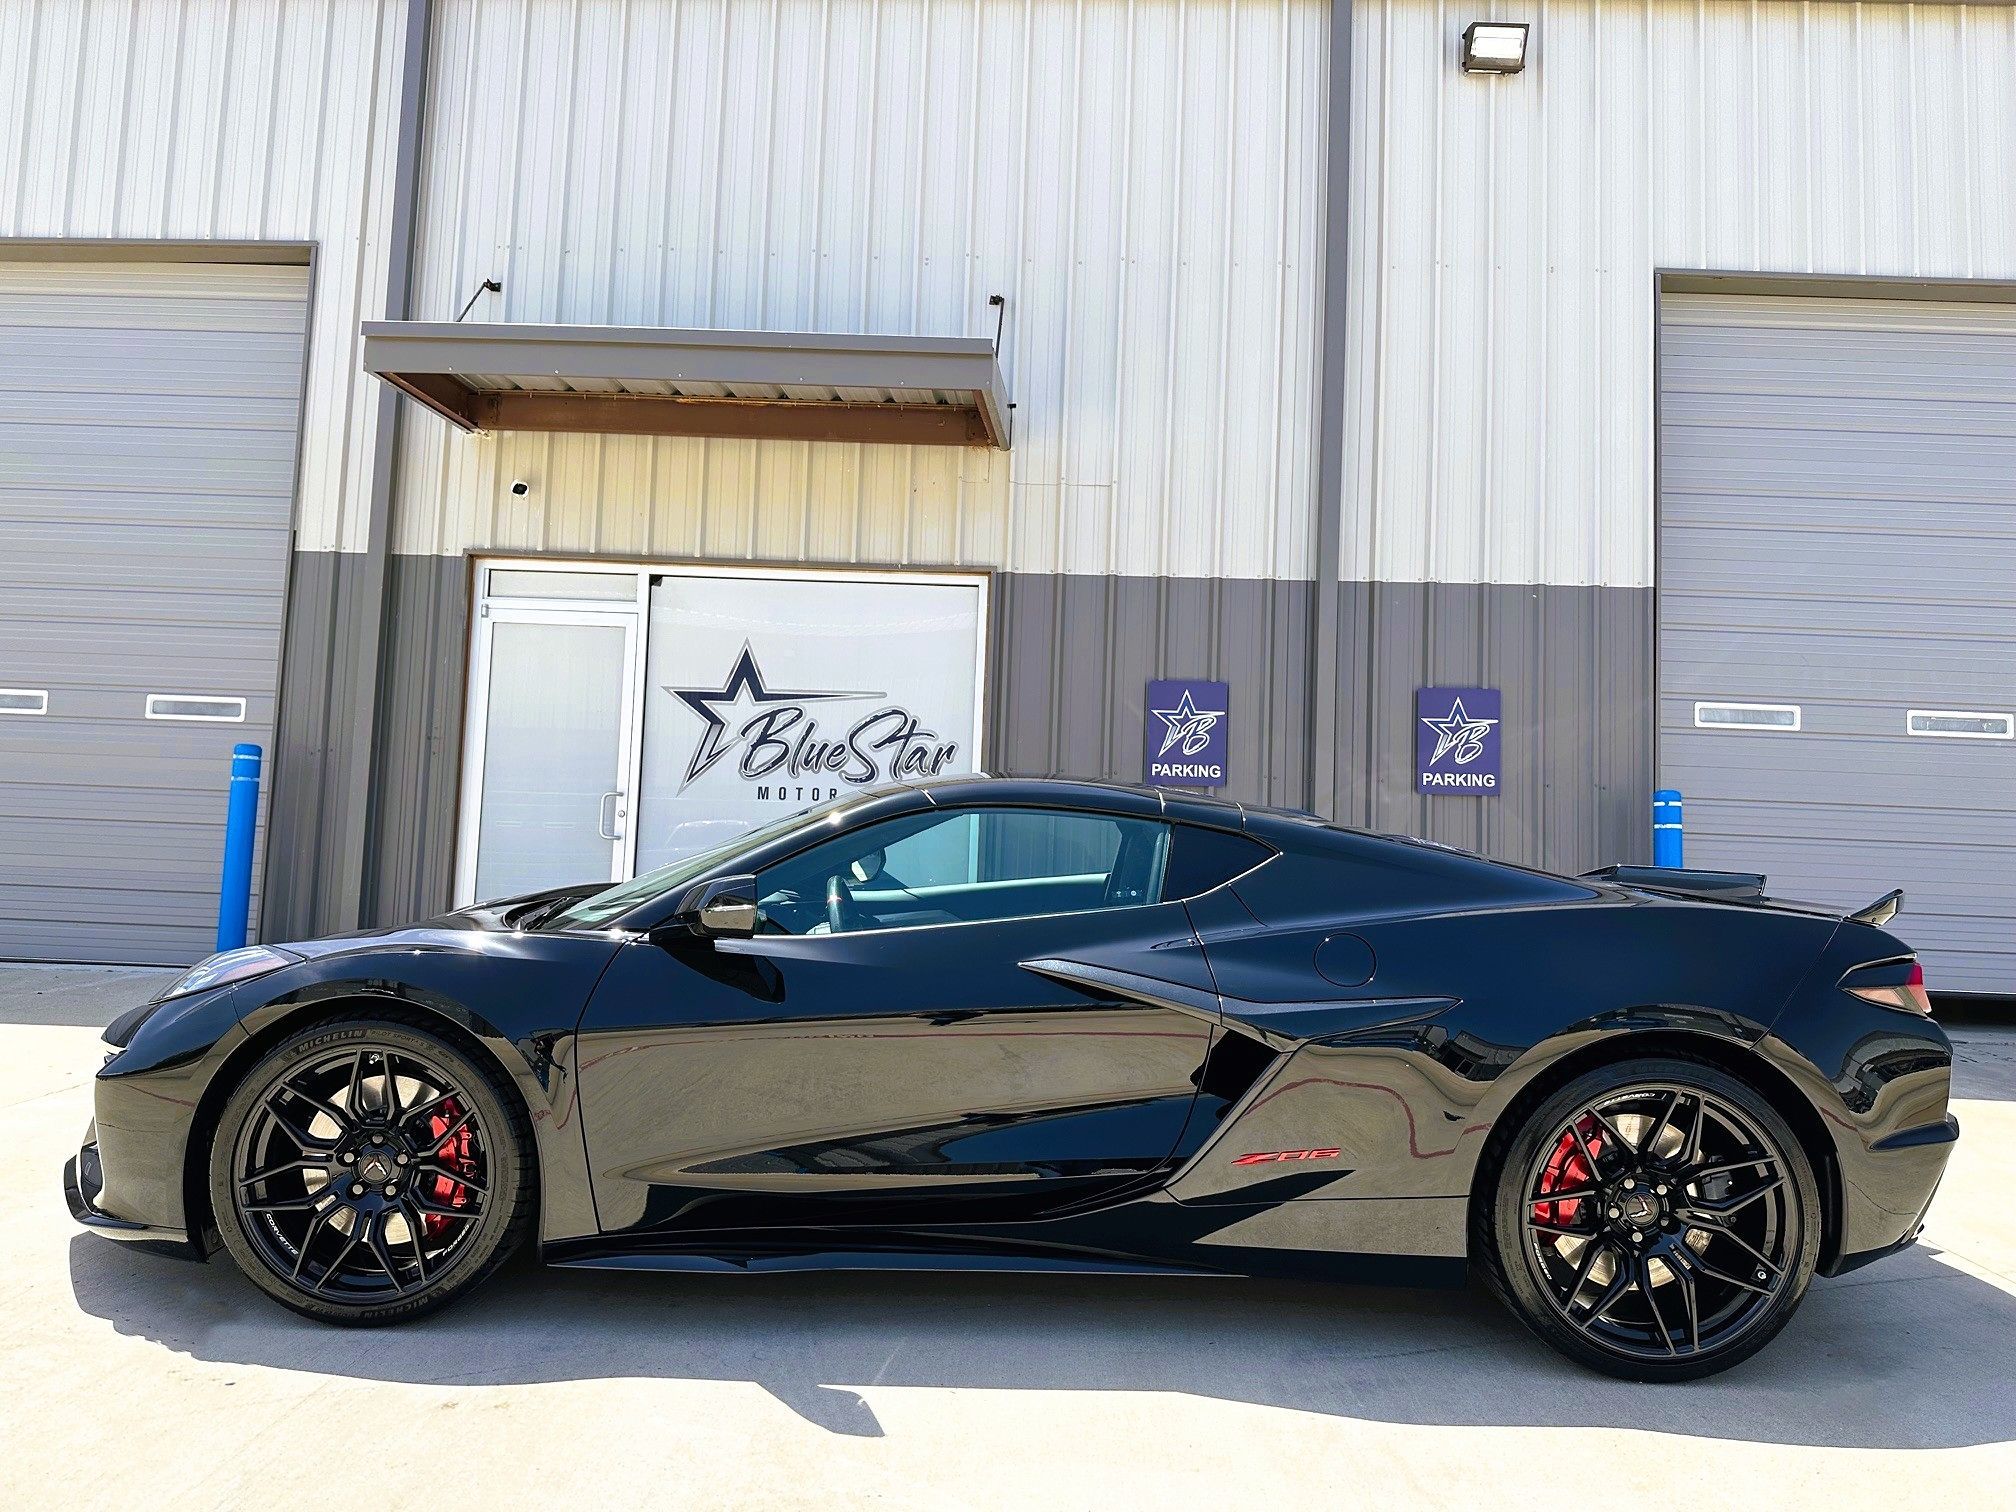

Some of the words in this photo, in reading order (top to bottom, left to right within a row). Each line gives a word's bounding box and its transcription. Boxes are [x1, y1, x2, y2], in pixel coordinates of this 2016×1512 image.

[738, 704, 957, 785] BlueStar
[1151, 763, 1221, 778] PARKING
[1422, 772, 1496, 787] PARKING
[298, 1030, 364, 1053] MICHELIN
[1231, 1148, 1341, 1165] Z06
[266, 1213, 299, 1255] CORVETTE
[442, 1224, 470, 1256] FORGED
